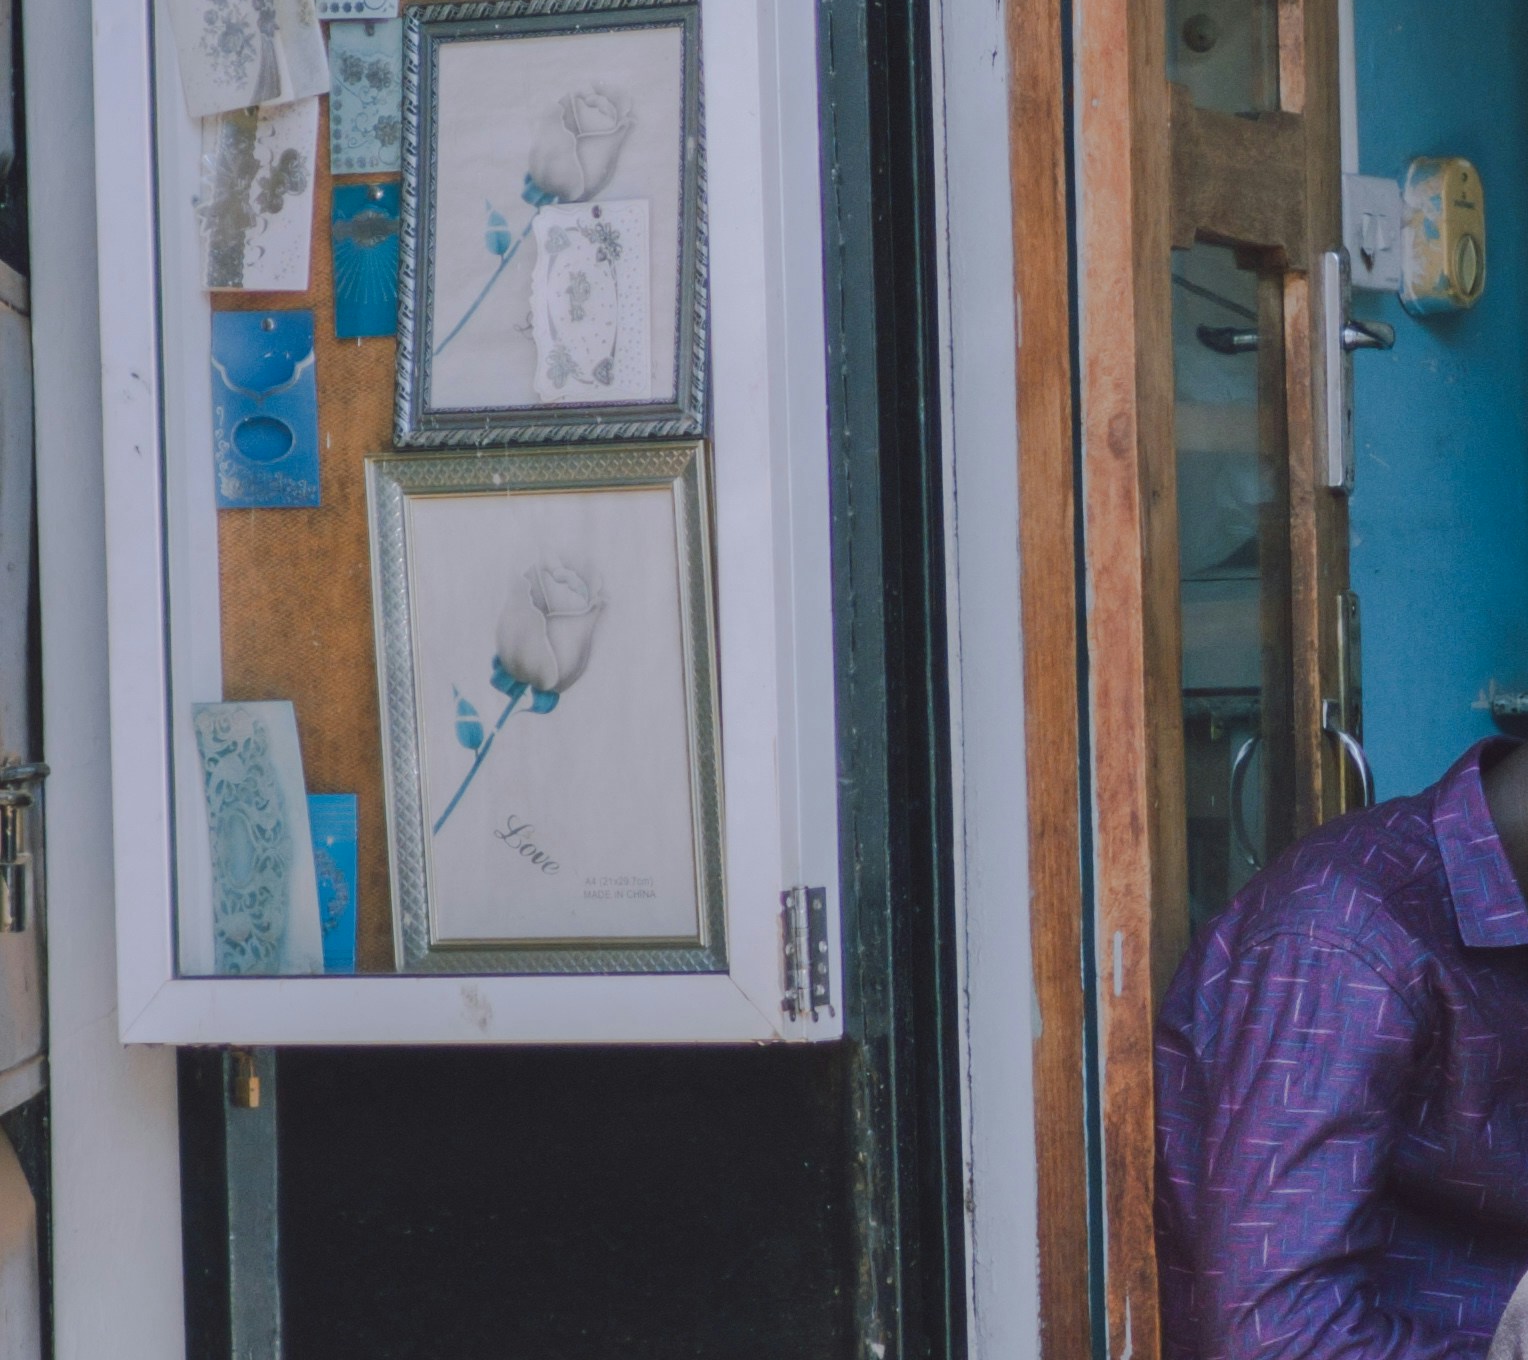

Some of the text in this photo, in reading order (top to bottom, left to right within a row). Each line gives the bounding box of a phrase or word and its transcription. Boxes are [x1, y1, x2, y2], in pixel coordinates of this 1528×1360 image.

[493, 813, 561, 876] Love
[583, 889, 657, 899] MADE IN CHINA
